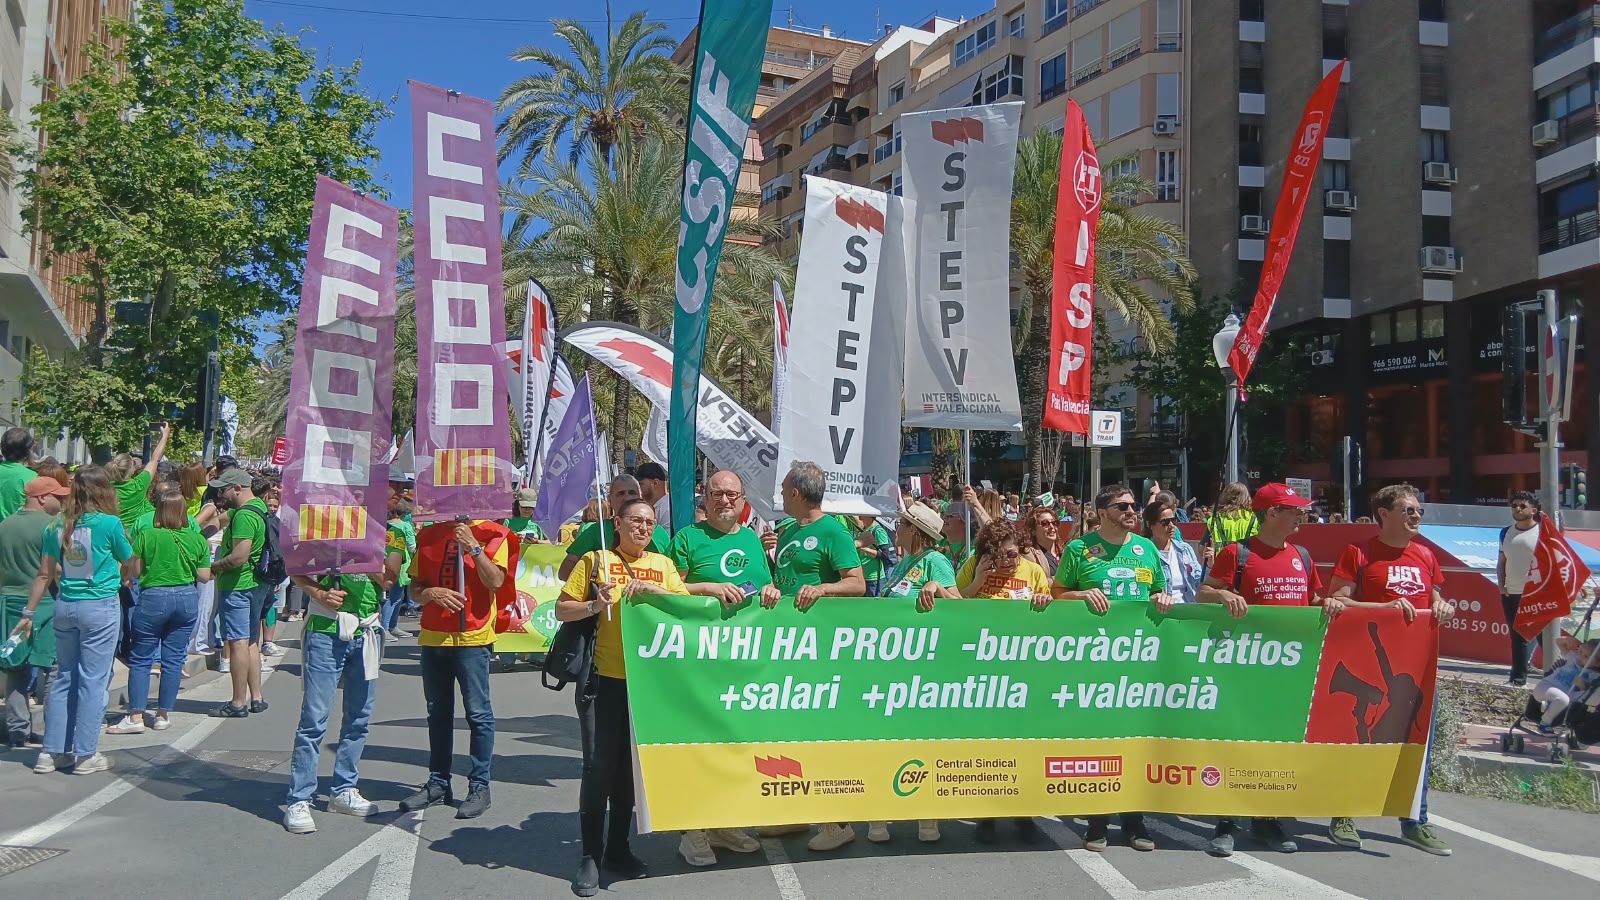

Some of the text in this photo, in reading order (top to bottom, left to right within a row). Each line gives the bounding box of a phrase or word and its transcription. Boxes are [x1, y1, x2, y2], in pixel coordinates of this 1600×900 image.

[675, 50, 750, 314] CSIF
[427, 111, 494, 425] CCOO
[939, 151, 968, 385] STEPV
[302, 203, 383, 486] CCOO
[830, 235, 867, 465] STEPV
[1402, 356, 1417, 365] 069
[922, 392, 1001, 402] INTERSINDICAL
[936, 404, 1001, 413] VALENCIANA
[824, 471, 878, 484] RSINDICAL
[825, 484, 876, 496] ENCIANA
[1388, 566, 1422, 584] UGT
[1517, 600, 1558, 614] .ugt.es
[1471, 620, 1487, 633] 59
[1491, 622, 1509, 635] 00
[638, 623, 685, 659] JA
[770, 626, 819, 661] HA
[830, 627, 940, 661] PROU!
[960, 628, 1160, 661] -burocràcia
[1183, 631, 1302, 666] -ràtios
[719, 674, 1218, 716] +salari +plantilla +valencià
[936, 758, 1016, 768] Central Sindical
[1049, 760, 1100, 774] CCOO
[936, 772, 1018, 784] Independiente y
[1146, 763, 1197, 785] UGT
[1229, 768, 1296, 779] Ensenyament
[761, 780, 810, 796] STEPV
[813, 779, 865, 787] INTERSINDICAL
[1046, 778, 1121, 794] educació
[1228, 782, 1257, 790] Serveis
[1286, 783, 1298, 791] PV
[937, 786, 1019, 796] de Funcionarios
